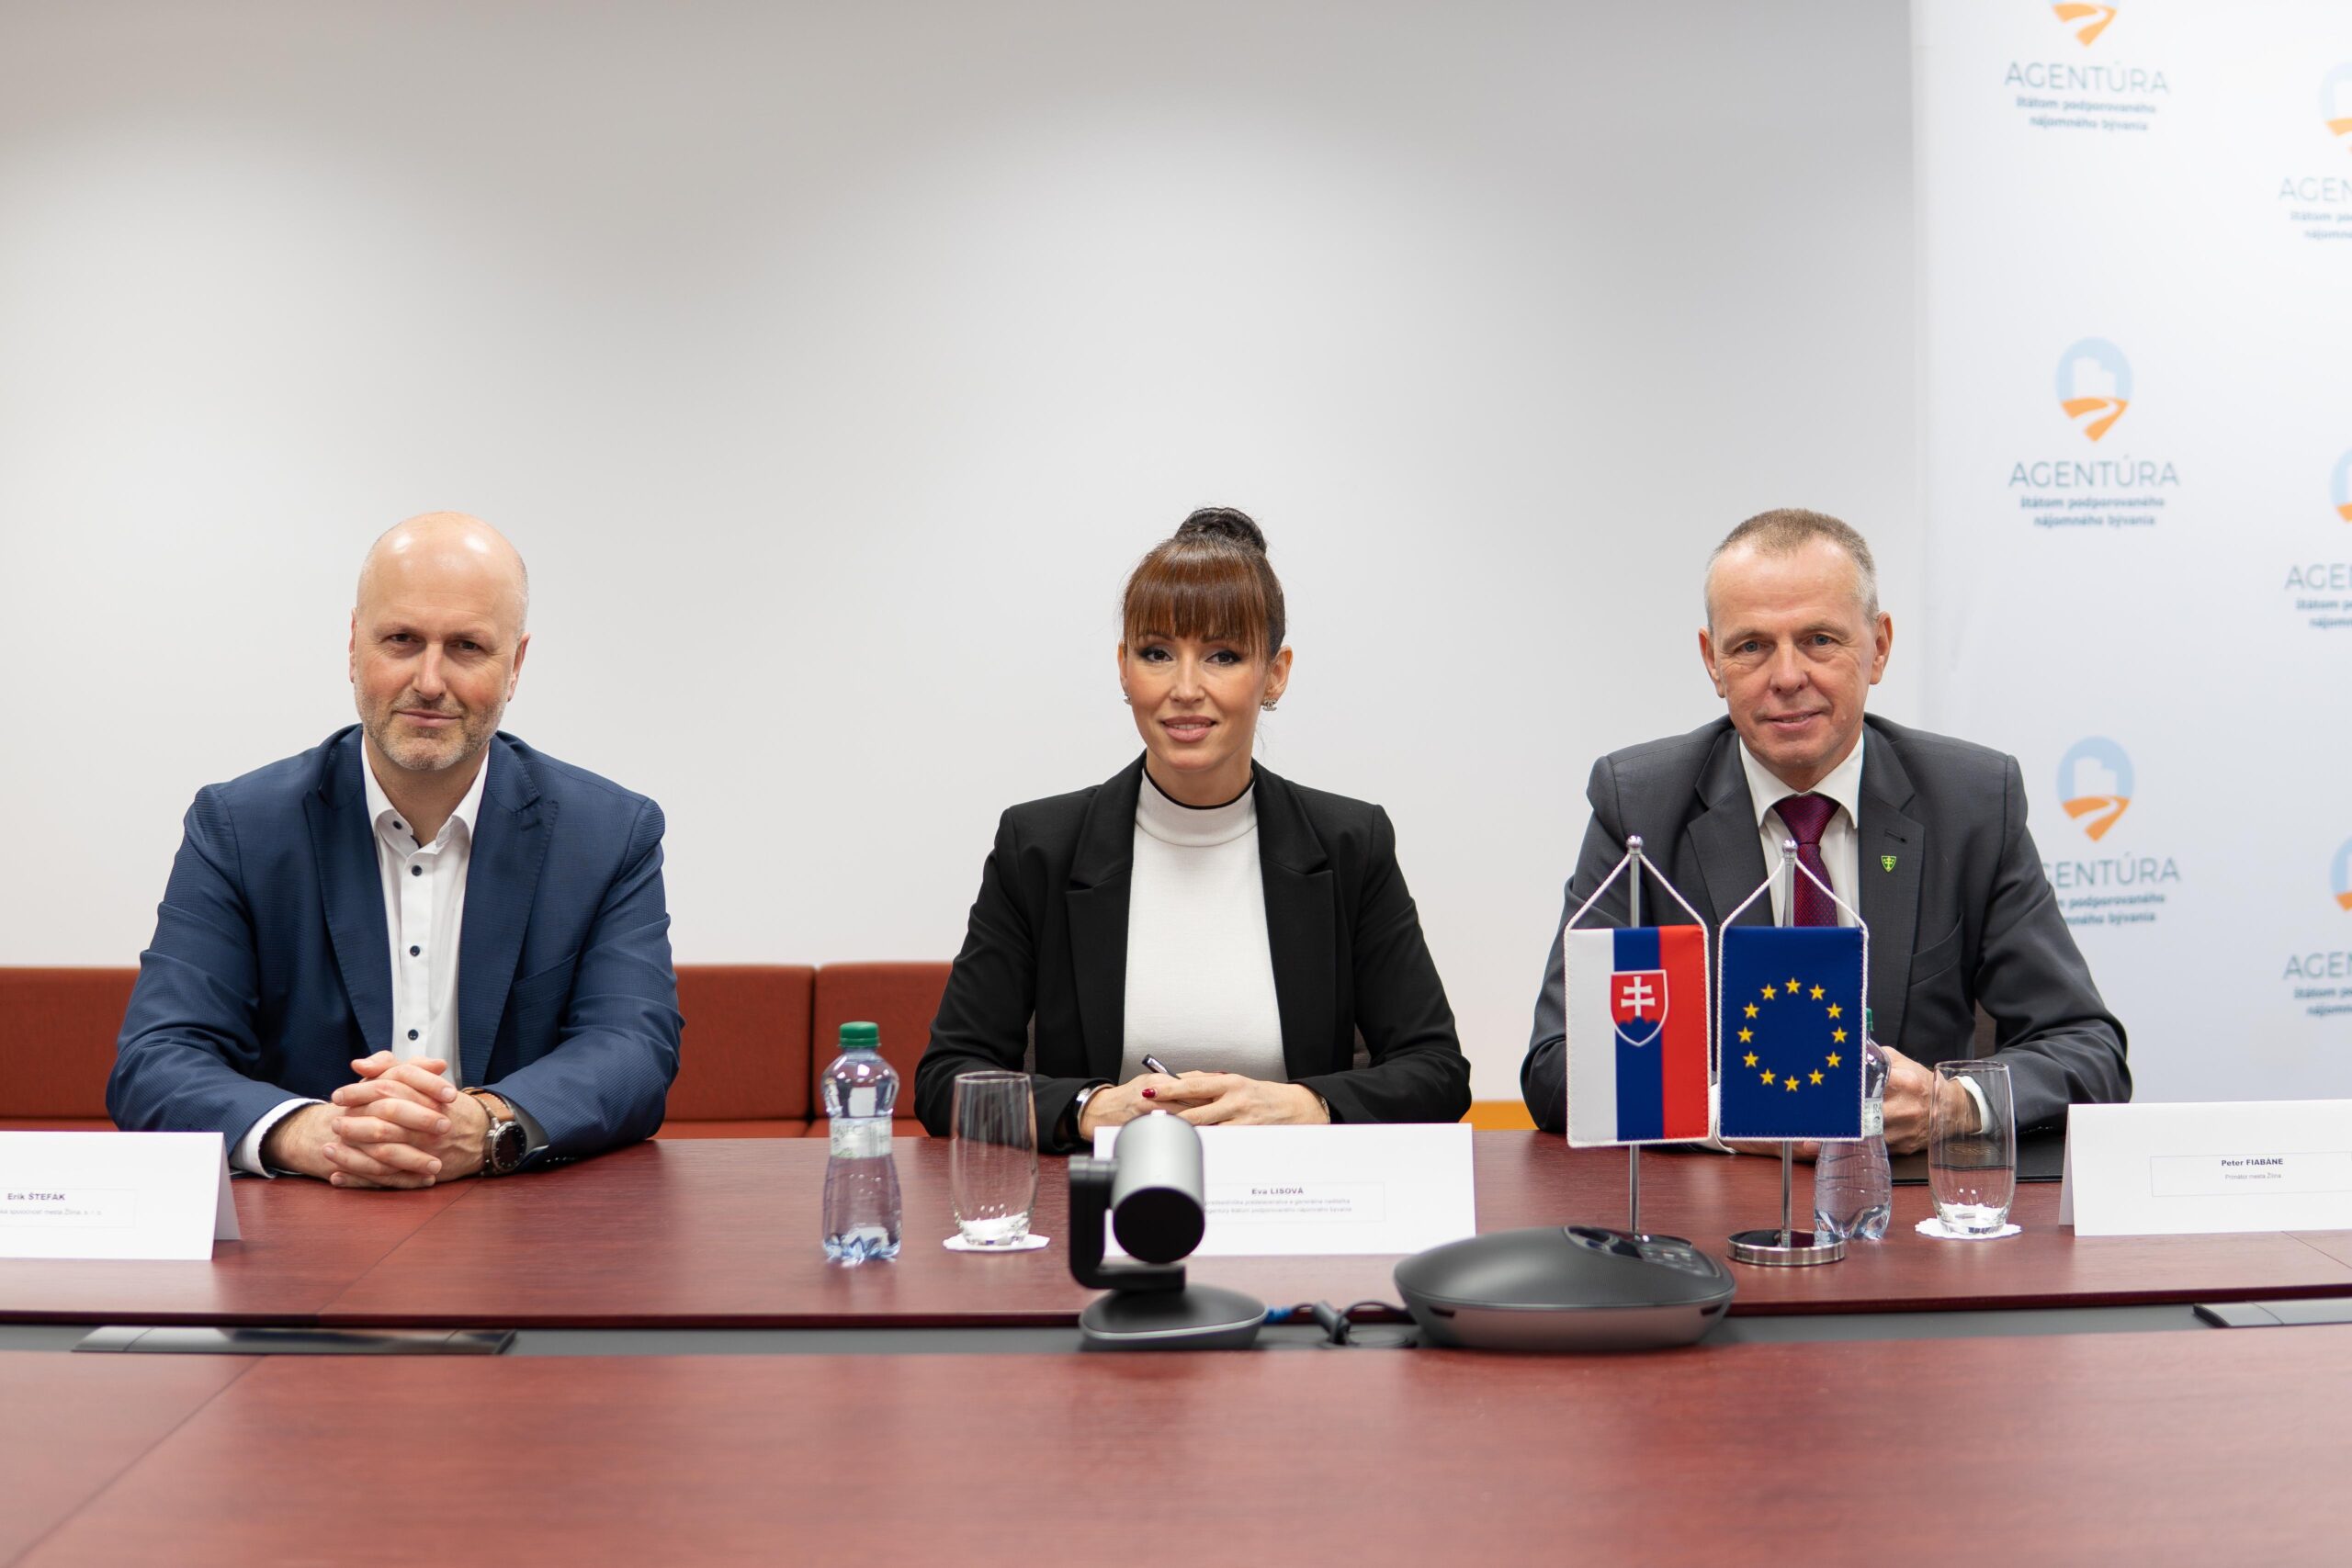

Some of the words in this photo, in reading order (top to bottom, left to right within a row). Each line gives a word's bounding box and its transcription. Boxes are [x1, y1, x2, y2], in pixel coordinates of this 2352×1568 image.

[2004, 61, 2171, 95] AGENTÚRA
[2008, 454, 2180, 488] AGENTÚRA
[2246, 1157, 2284, 1166] FIABÁNE
[7, 1192, 25, 1201] Erik
